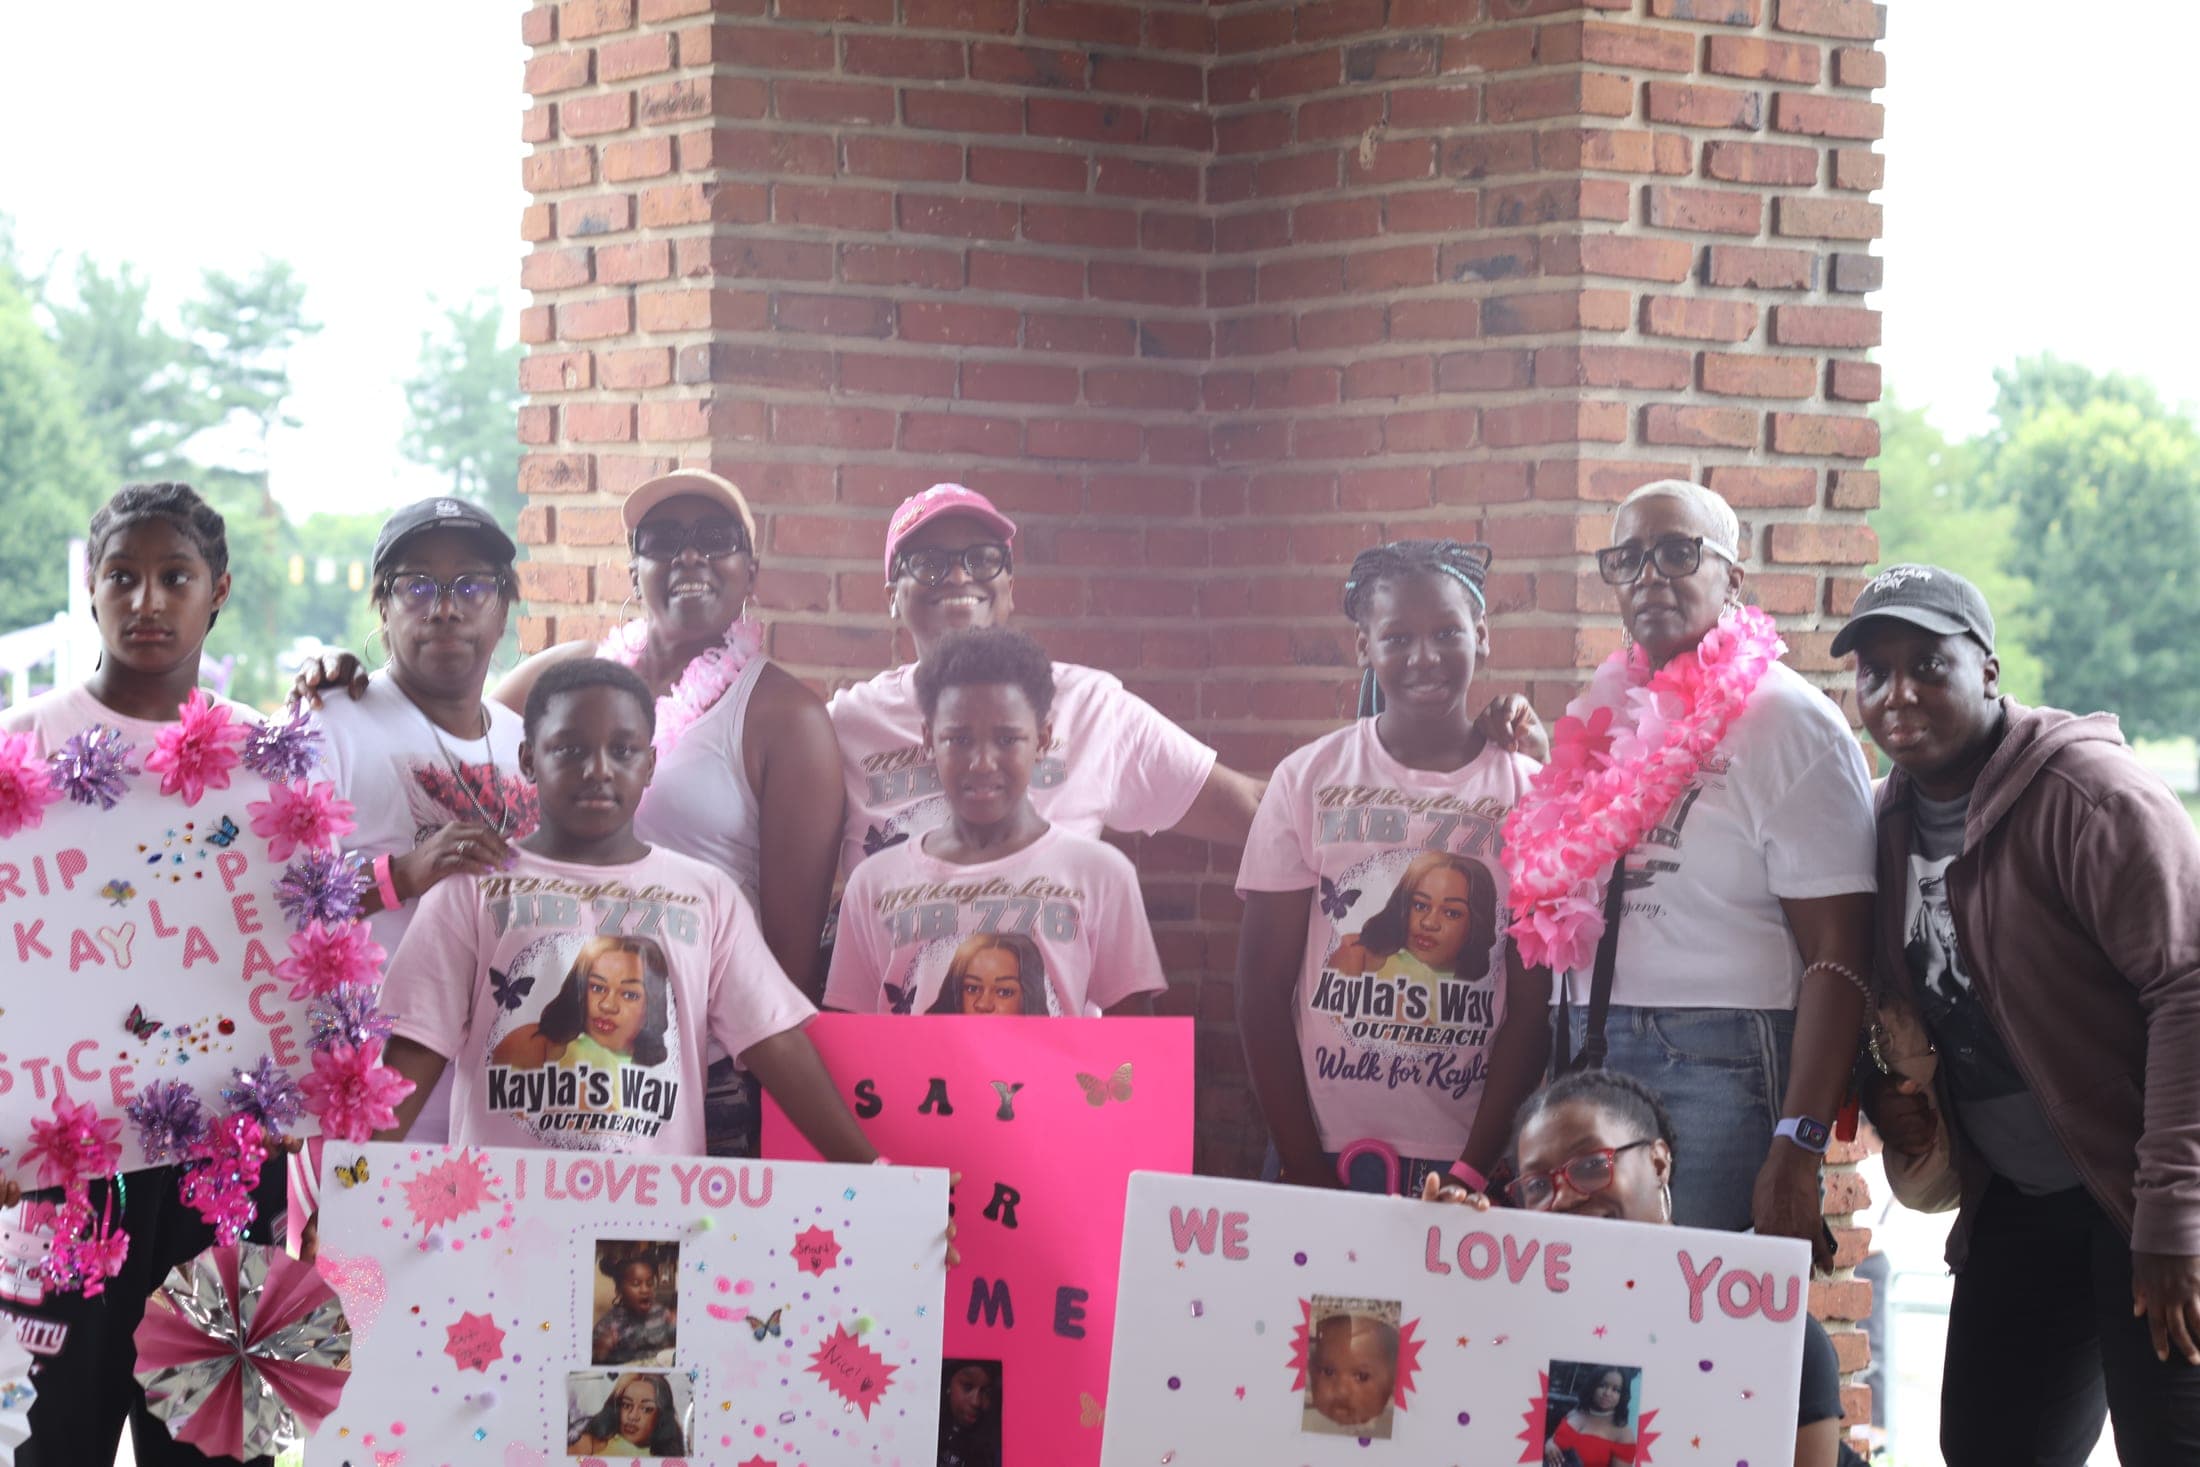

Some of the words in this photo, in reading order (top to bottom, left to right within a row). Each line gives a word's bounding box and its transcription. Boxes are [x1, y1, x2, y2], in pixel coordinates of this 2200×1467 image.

[1423, 811, 1504, 858] 77
[0, 848, 88, 904] RIP
[13, 898, 219, 973] KAYLA
[593, 898, 701, 946] 776
[970, 898, 1080, 942] 776
[216, 850, 299, 1068] PEACE
[1311, 972, 1428, 1019] Kayla's
[1440, 982, 1495, 1028] Way
[1352, 1021, 1488, 1047] OUTREACH
[1316, 1046, 1383, 1081] Walk
[1387, 1057, 1422, 1089] for
[488, 1065, 610, 1114] Kayla's
[621, 1068, 678, 1121] Way
[854, 1077, 1025, 1121] SAY
[539, 1112, 661, 1137] OUTREACH
[514, 1158, 527, 1201] I
[544, 1158, 661, 1207] LOVE
[671, 1163, 775, 1208] YOU
[1169, 1206, 1250, 1261] WE
[1425, 1225, 1572, 1293] LOVE
[1677, 1249, 1800, 1323] YOU
[16, 1316, 68, 1350] KITTY
